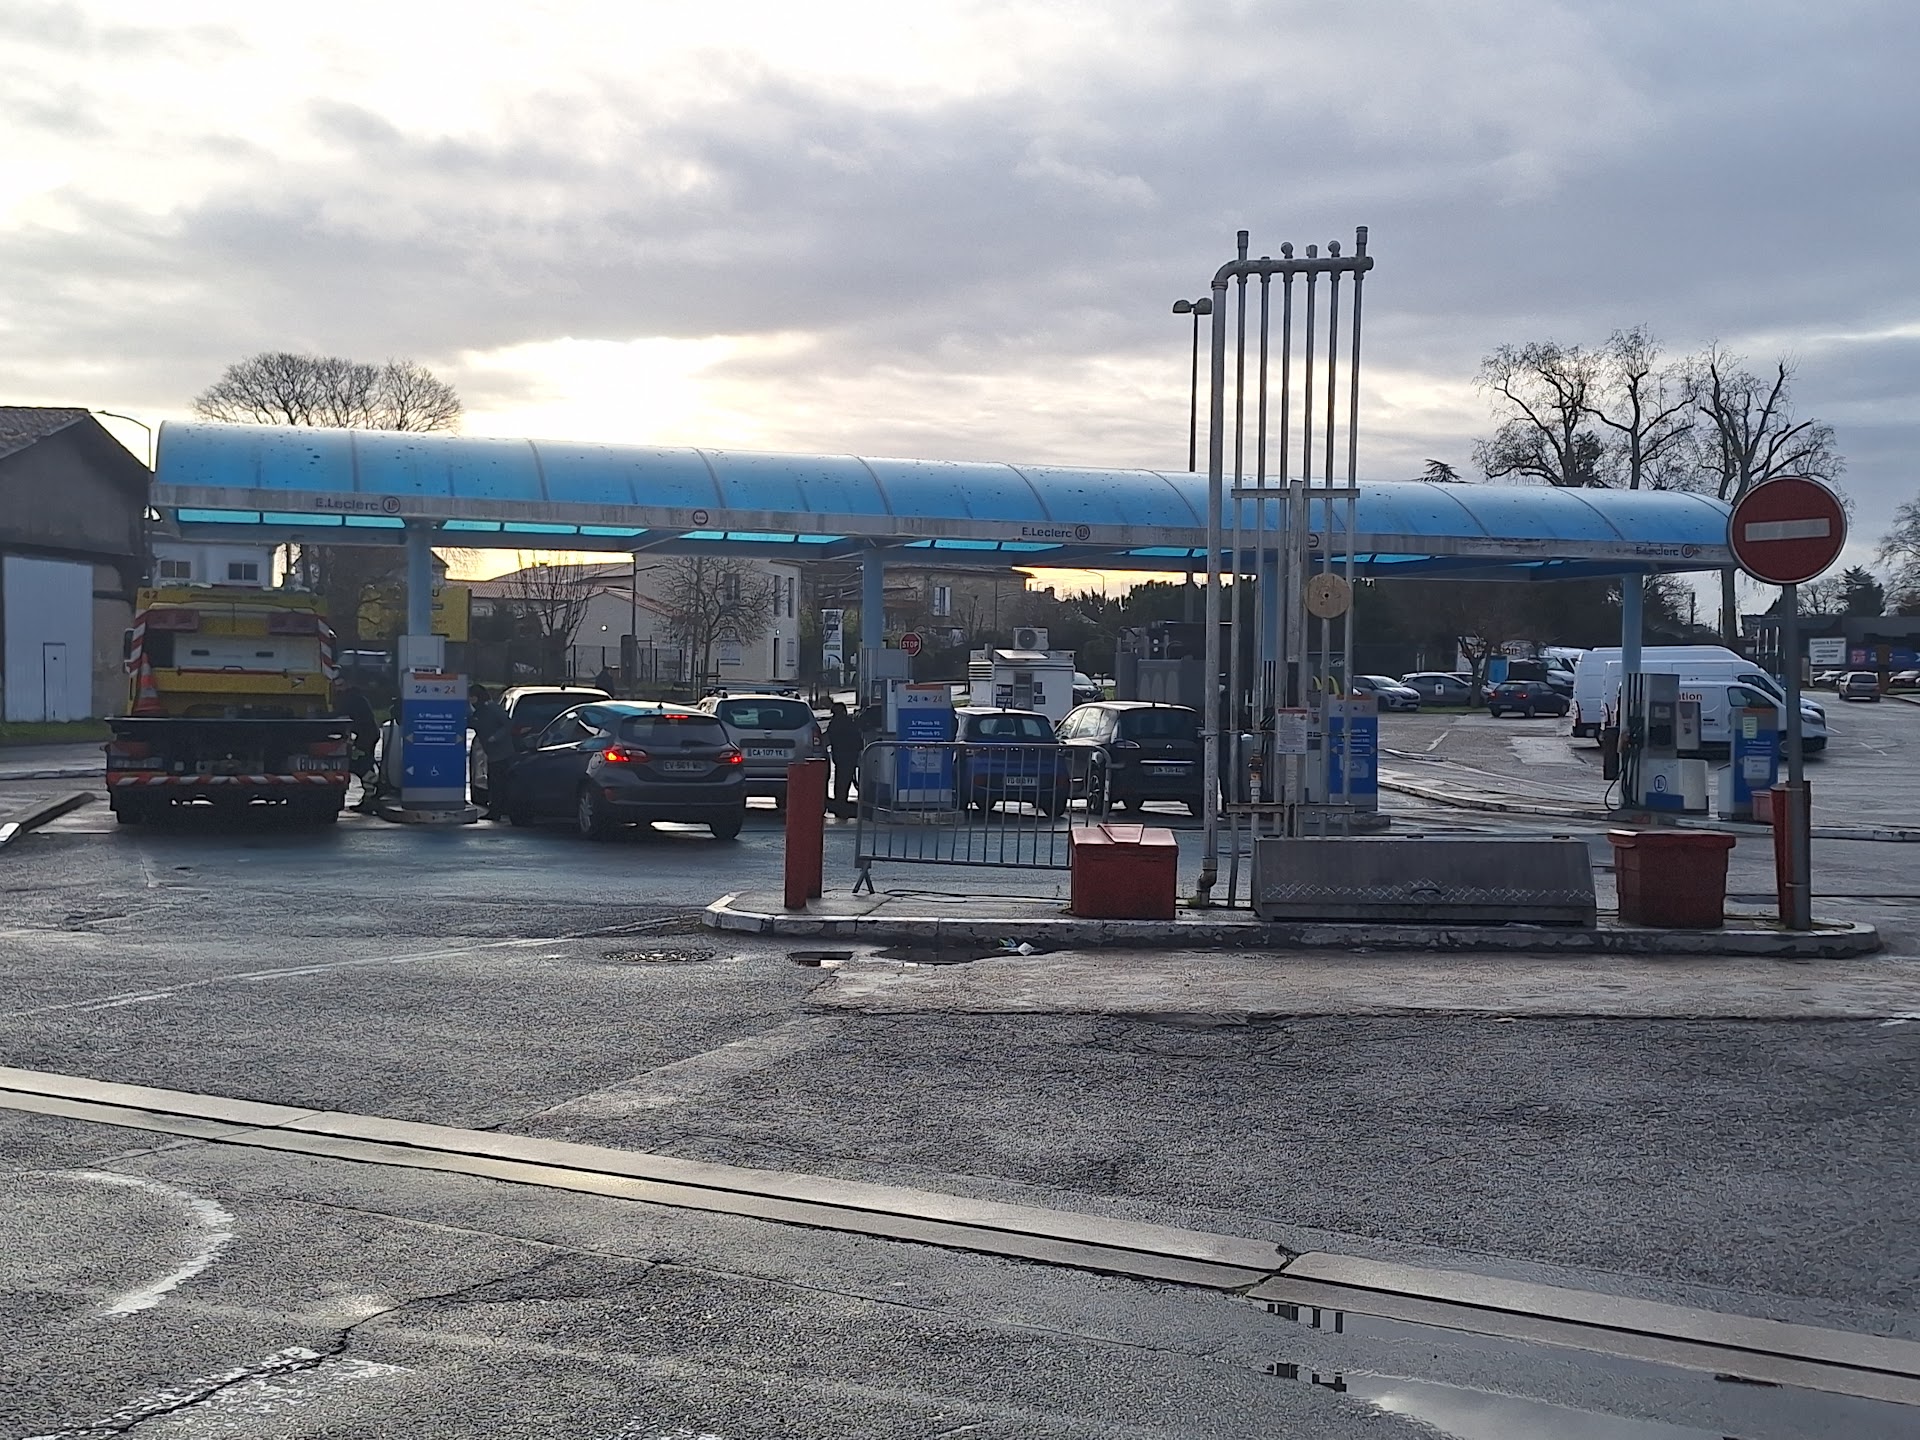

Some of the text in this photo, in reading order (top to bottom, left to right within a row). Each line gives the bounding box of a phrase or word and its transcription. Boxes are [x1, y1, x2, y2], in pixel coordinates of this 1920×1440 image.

[315, 497, 379, 511] E.Leclerc
[1022, 526, 1072, 538] E.Leclerc
[902, 641, 919, 649] STOP
[415, 685, 427, 694] 24
[907, 695, 918, 703] 24
